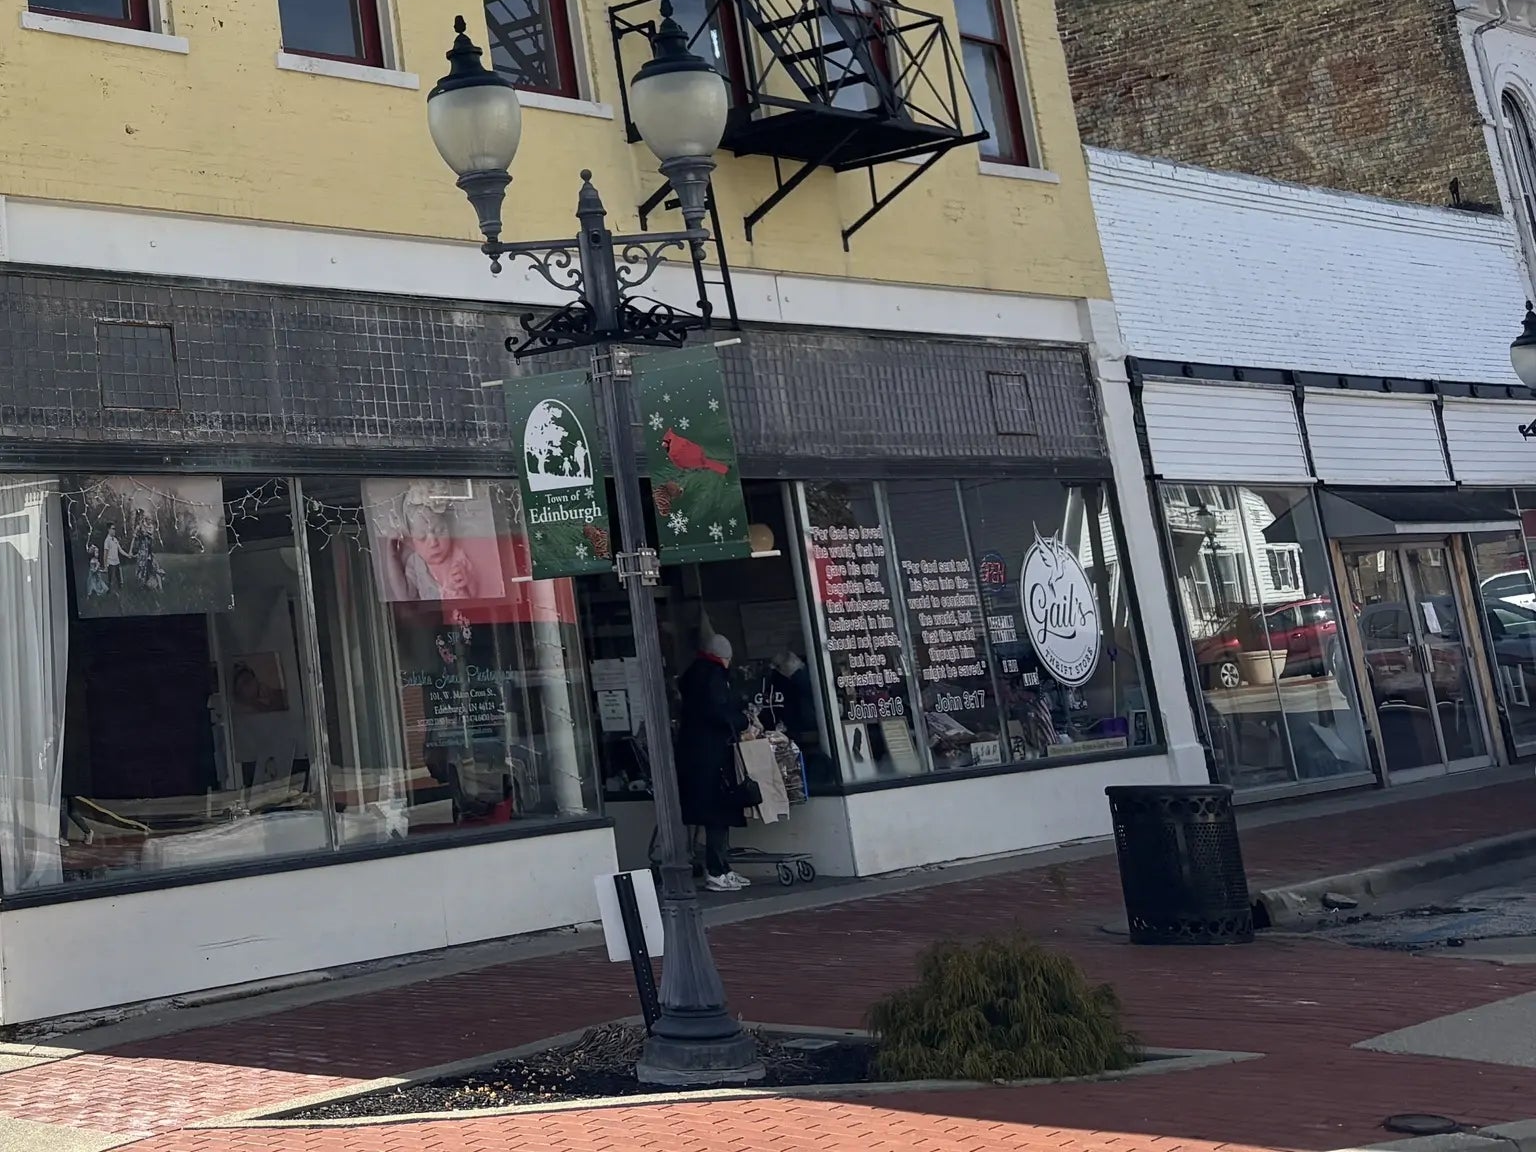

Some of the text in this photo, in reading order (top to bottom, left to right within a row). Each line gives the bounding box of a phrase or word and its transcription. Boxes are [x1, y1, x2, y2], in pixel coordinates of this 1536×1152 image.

[545, 491, 581, 504] Town of
[529, 502, 602, 524] Edinburgh
[829, 526, 848, 540] God
[848, 528, 860, 540] so
[860, 525, 884, 539] loved
[813, 545, 828, 559] the
[855, 543, 873, 557] that
[873, 543, 885, 557] he
[826, 561, 879, 579] gave his only
[920, 560, 938, 573] God
[938, 560, 956, 573] sent
[956, 559, 970, 572] not
[826, 581, 864, 597] begotten
[909, 576, 969, 592] his Son into the
[826, 598, 890, 613] that whosoever
[908, 594, 977, 609] world to condemn
[919, 613, 933, 627] the
[958, 611, 972, 623] but
[1030, 583, 1094, 644] Gail's
[828, 614, 894, 632] believeth in him
[828, 635, 857, 651] should
[857, 634, 873, 649] not
[922, 628, 976, 644] that the world
[849, 652, 887, 668] but have
[960, 646, 976, 658] him
[1045, 649, 1073, 676] THRIFT
[838, 671, 884, 688] everlasting
[923, 665, 946, 682] might
[946, 664, 957, 678] be
[754, 692, 784, 704] GD
[936, 690, 985, 712] John 3:17
[848, 697, 904, 720] John 3:16
